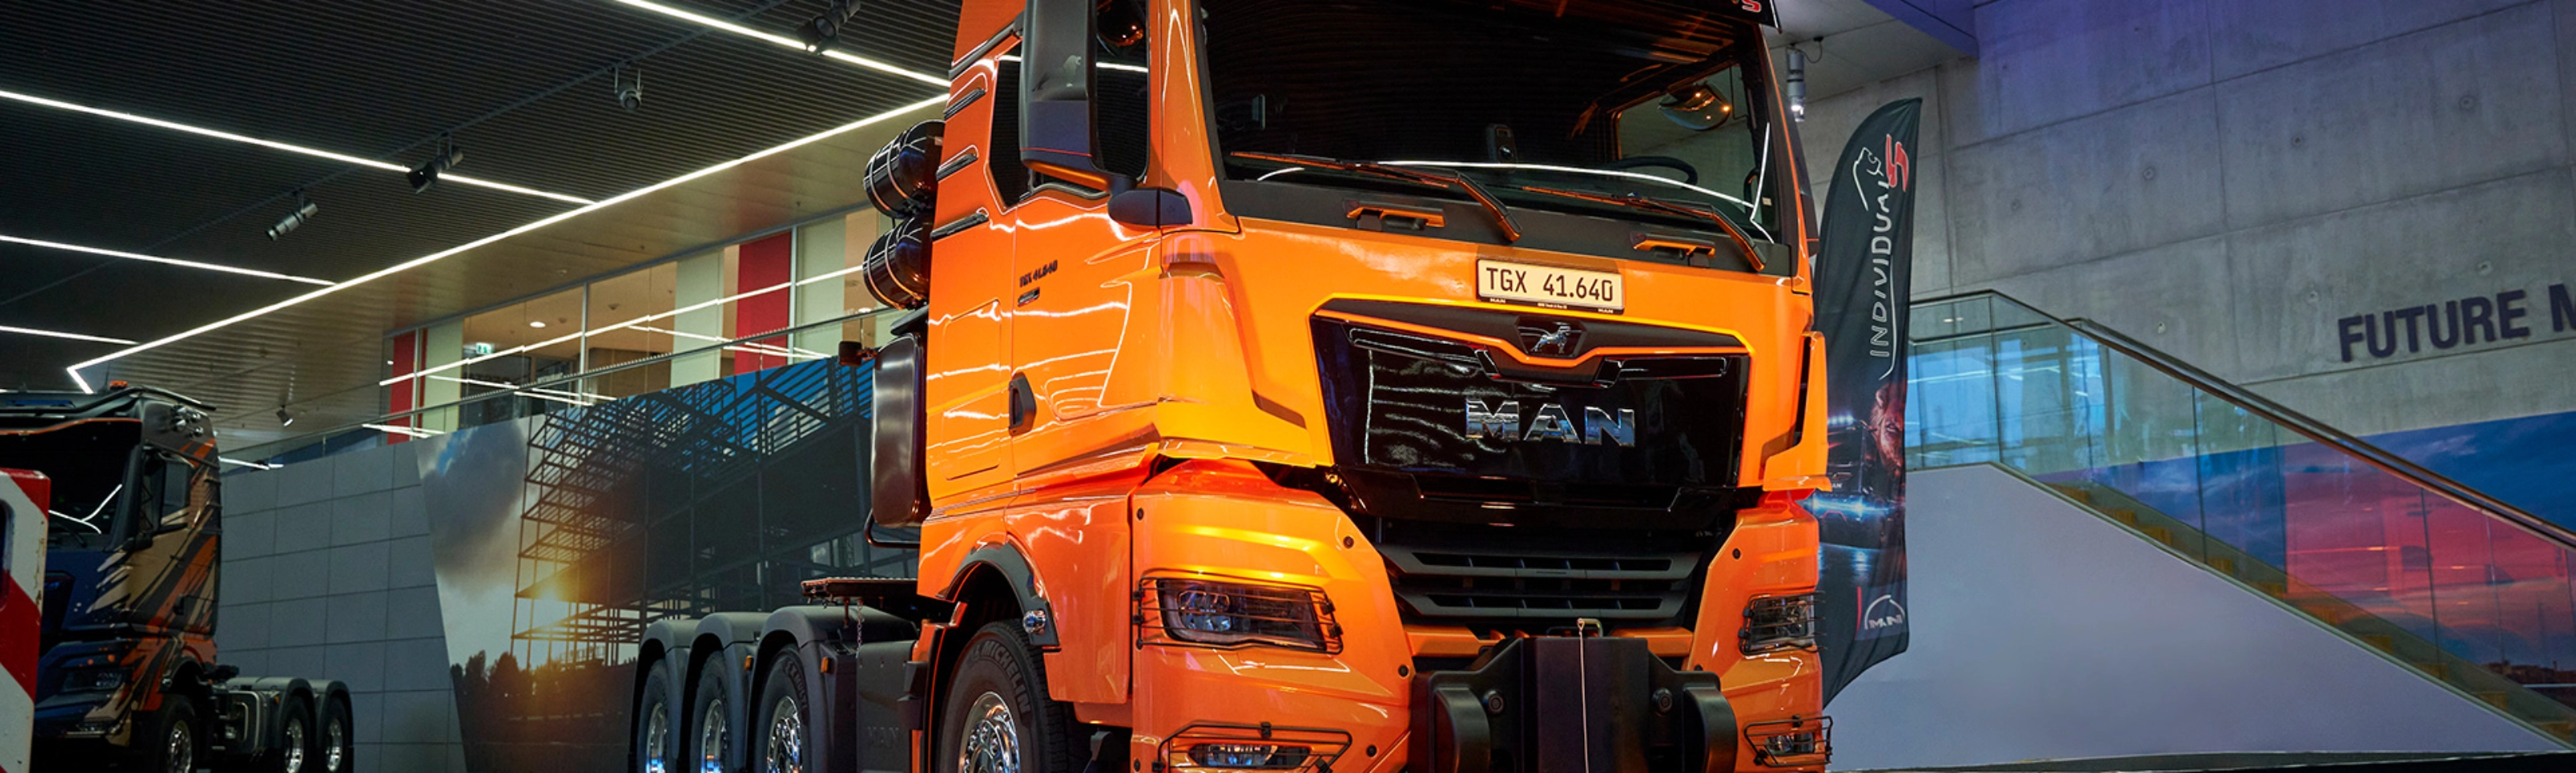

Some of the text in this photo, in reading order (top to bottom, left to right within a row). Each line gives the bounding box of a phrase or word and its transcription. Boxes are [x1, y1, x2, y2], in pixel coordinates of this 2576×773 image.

[1486, 267, 1613, 302] TGX 41.640
[1869, 180, 1893, 358] INDIVIDUAL
[2338, 289, 2530, 362] FUTURE
[1465, 399, 1635, 447] MAN
[1868, 614, 1903, 629] MAN
[982, 640, 1031, 713] MICHELIN
